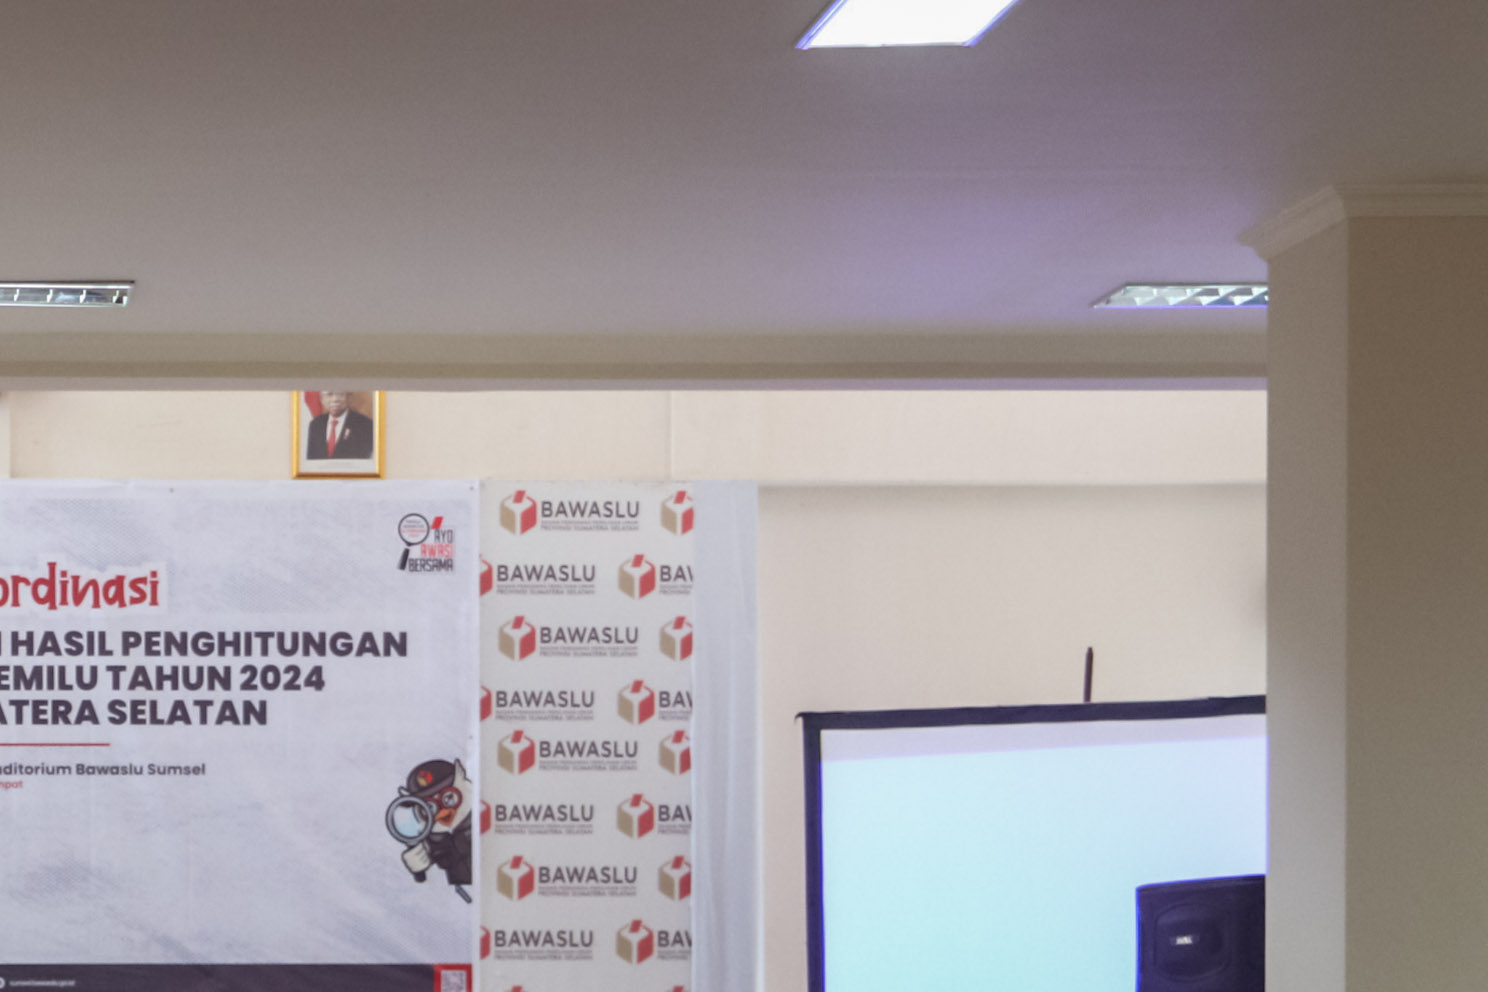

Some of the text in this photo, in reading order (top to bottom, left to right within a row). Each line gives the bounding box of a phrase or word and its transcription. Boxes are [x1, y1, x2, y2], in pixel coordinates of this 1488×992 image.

[541, 501, 640, 518] BAWASLU
[408, 558, 453, 572] BERSAMA
[497, 565, 595, 582] BAWASLU
[11, 631, 114, 656] HASIL
[121, 631, 408, 657] PENGHITUNGAN
[540, 627, 638, 644] BAWASLU
[106, 665, 231, 691] TAHUN
[239, 665, 326, 691] 2024
[496, 691, 594, 708] BAWASLU
[107, 700, 268, 725] SELATAN
[539, 741, 638, 758] BAWASLU
[76, 764, 143, 775] Bawaslu
[148, 763, 206, 775] Sumsel
[495, 804, 594, 821] BAWASLU
[538, 866, 637, 883] BAWASLU
[494, 930, 593, 947] BAWASLU
